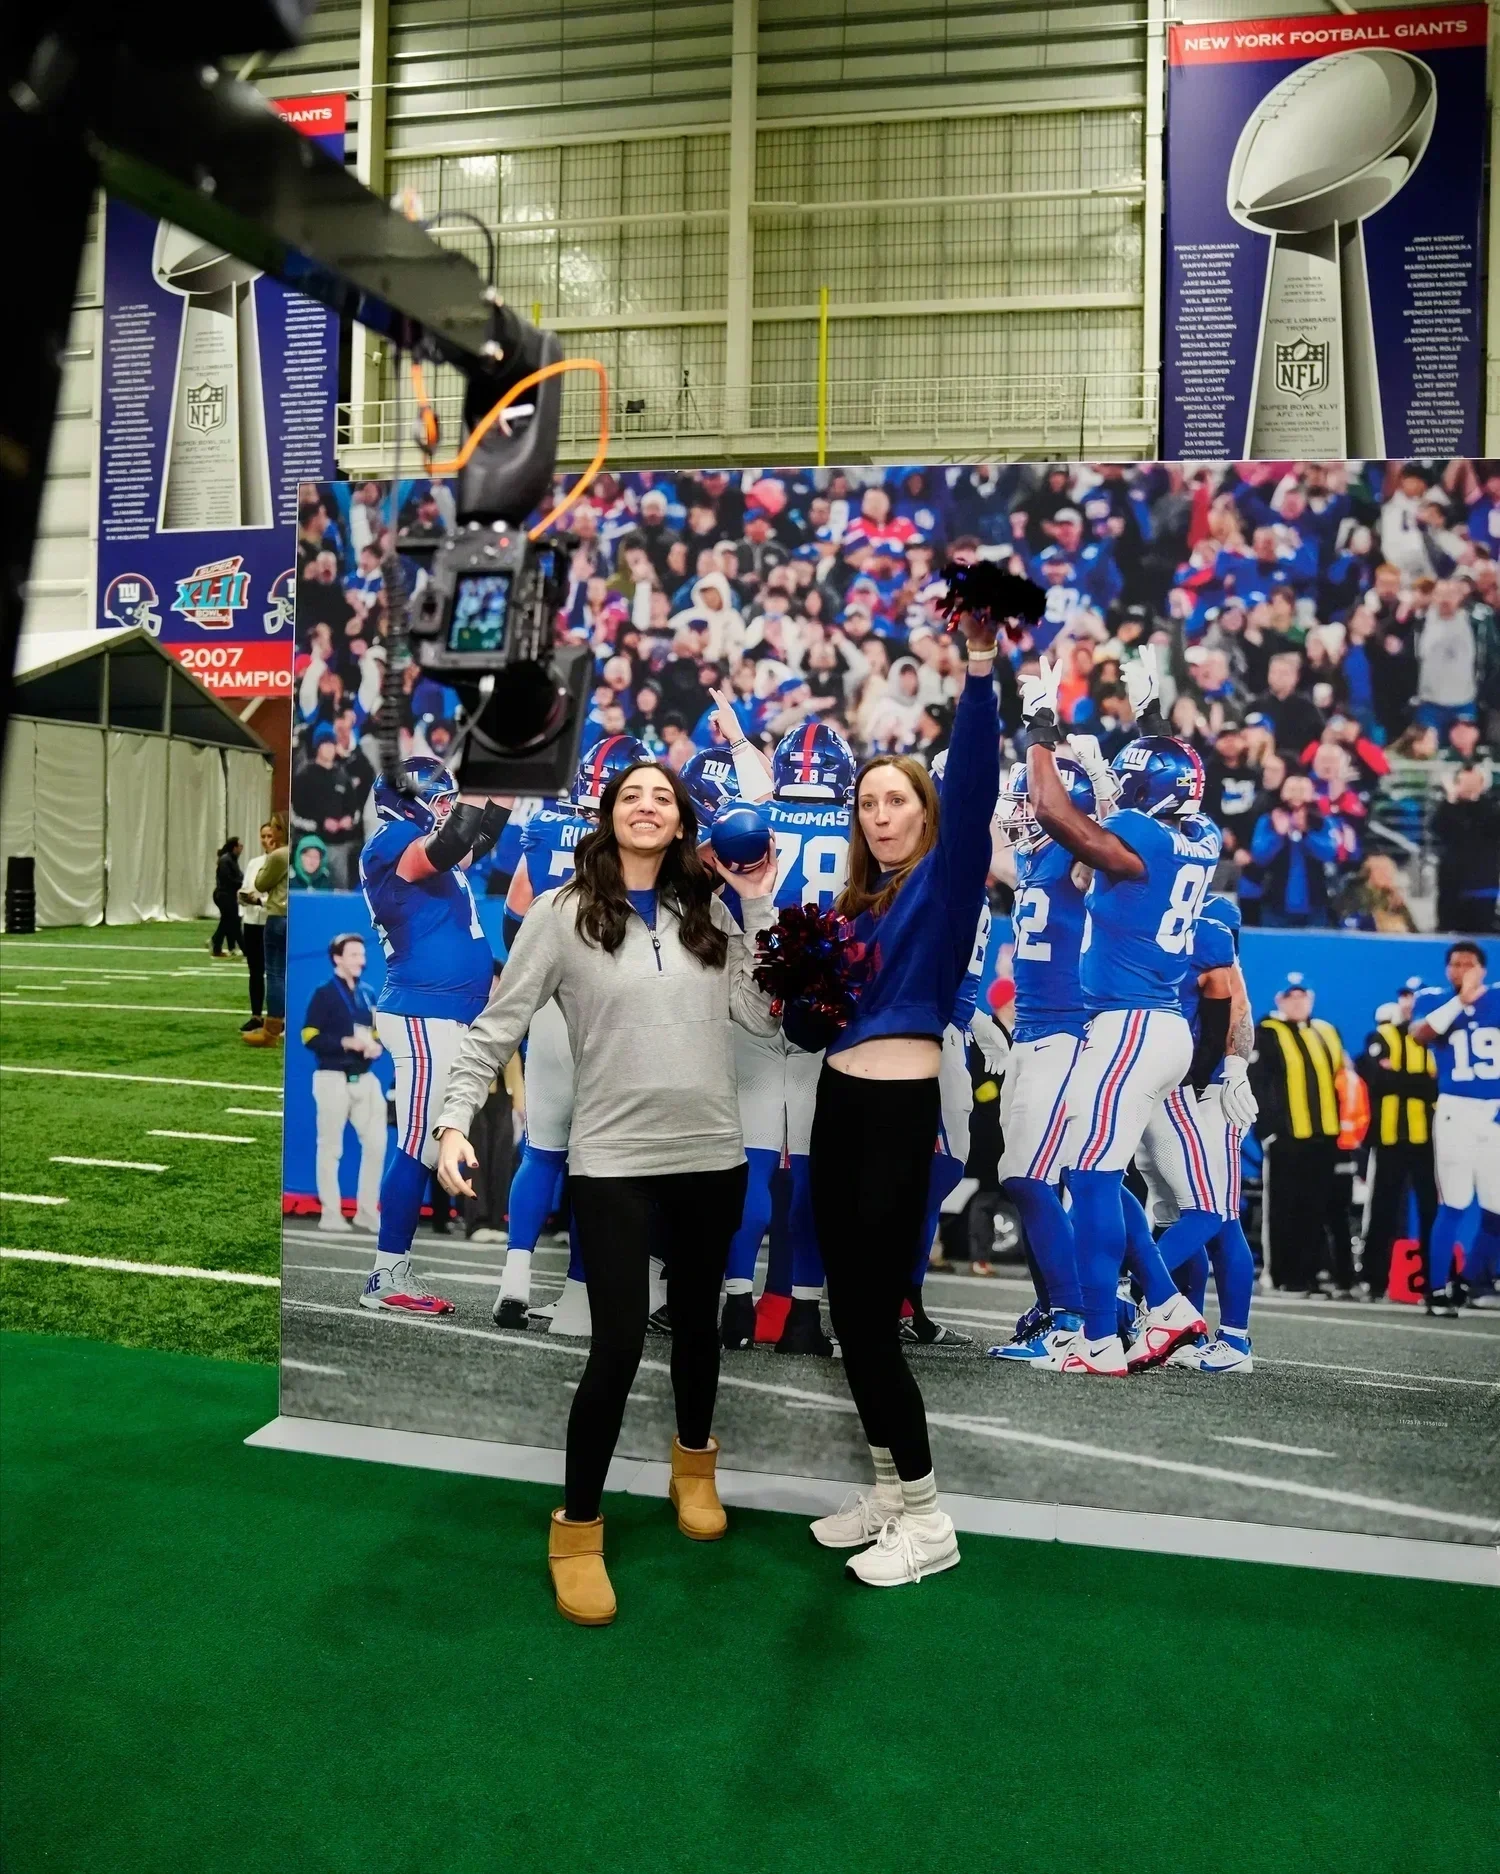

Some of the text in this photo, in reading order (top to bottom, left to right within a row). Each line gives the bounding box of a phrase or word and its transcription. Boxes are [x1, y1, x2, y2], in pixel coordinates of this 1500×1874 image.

[1184, 20, 1468, 51] NEW YORK FOOTBALL GIANTS
[279, 108, 332, 122] GIANTS
[1281, 362, 1321, 390] NFL
[191, 405, 220, 427] NFL
[199, 561, 233, 576] SUPER
[174, 575, 246, 608] XLII
[195, 609, 222, 617] BOWL
[180, 648, 243, 667] 2007
[794, 769, 818, 783] 78
[769, 807, 850, 827] THOMAS
[773, 832, 850, 910] 78
[1449, 1027, 1500, 1082] 19
